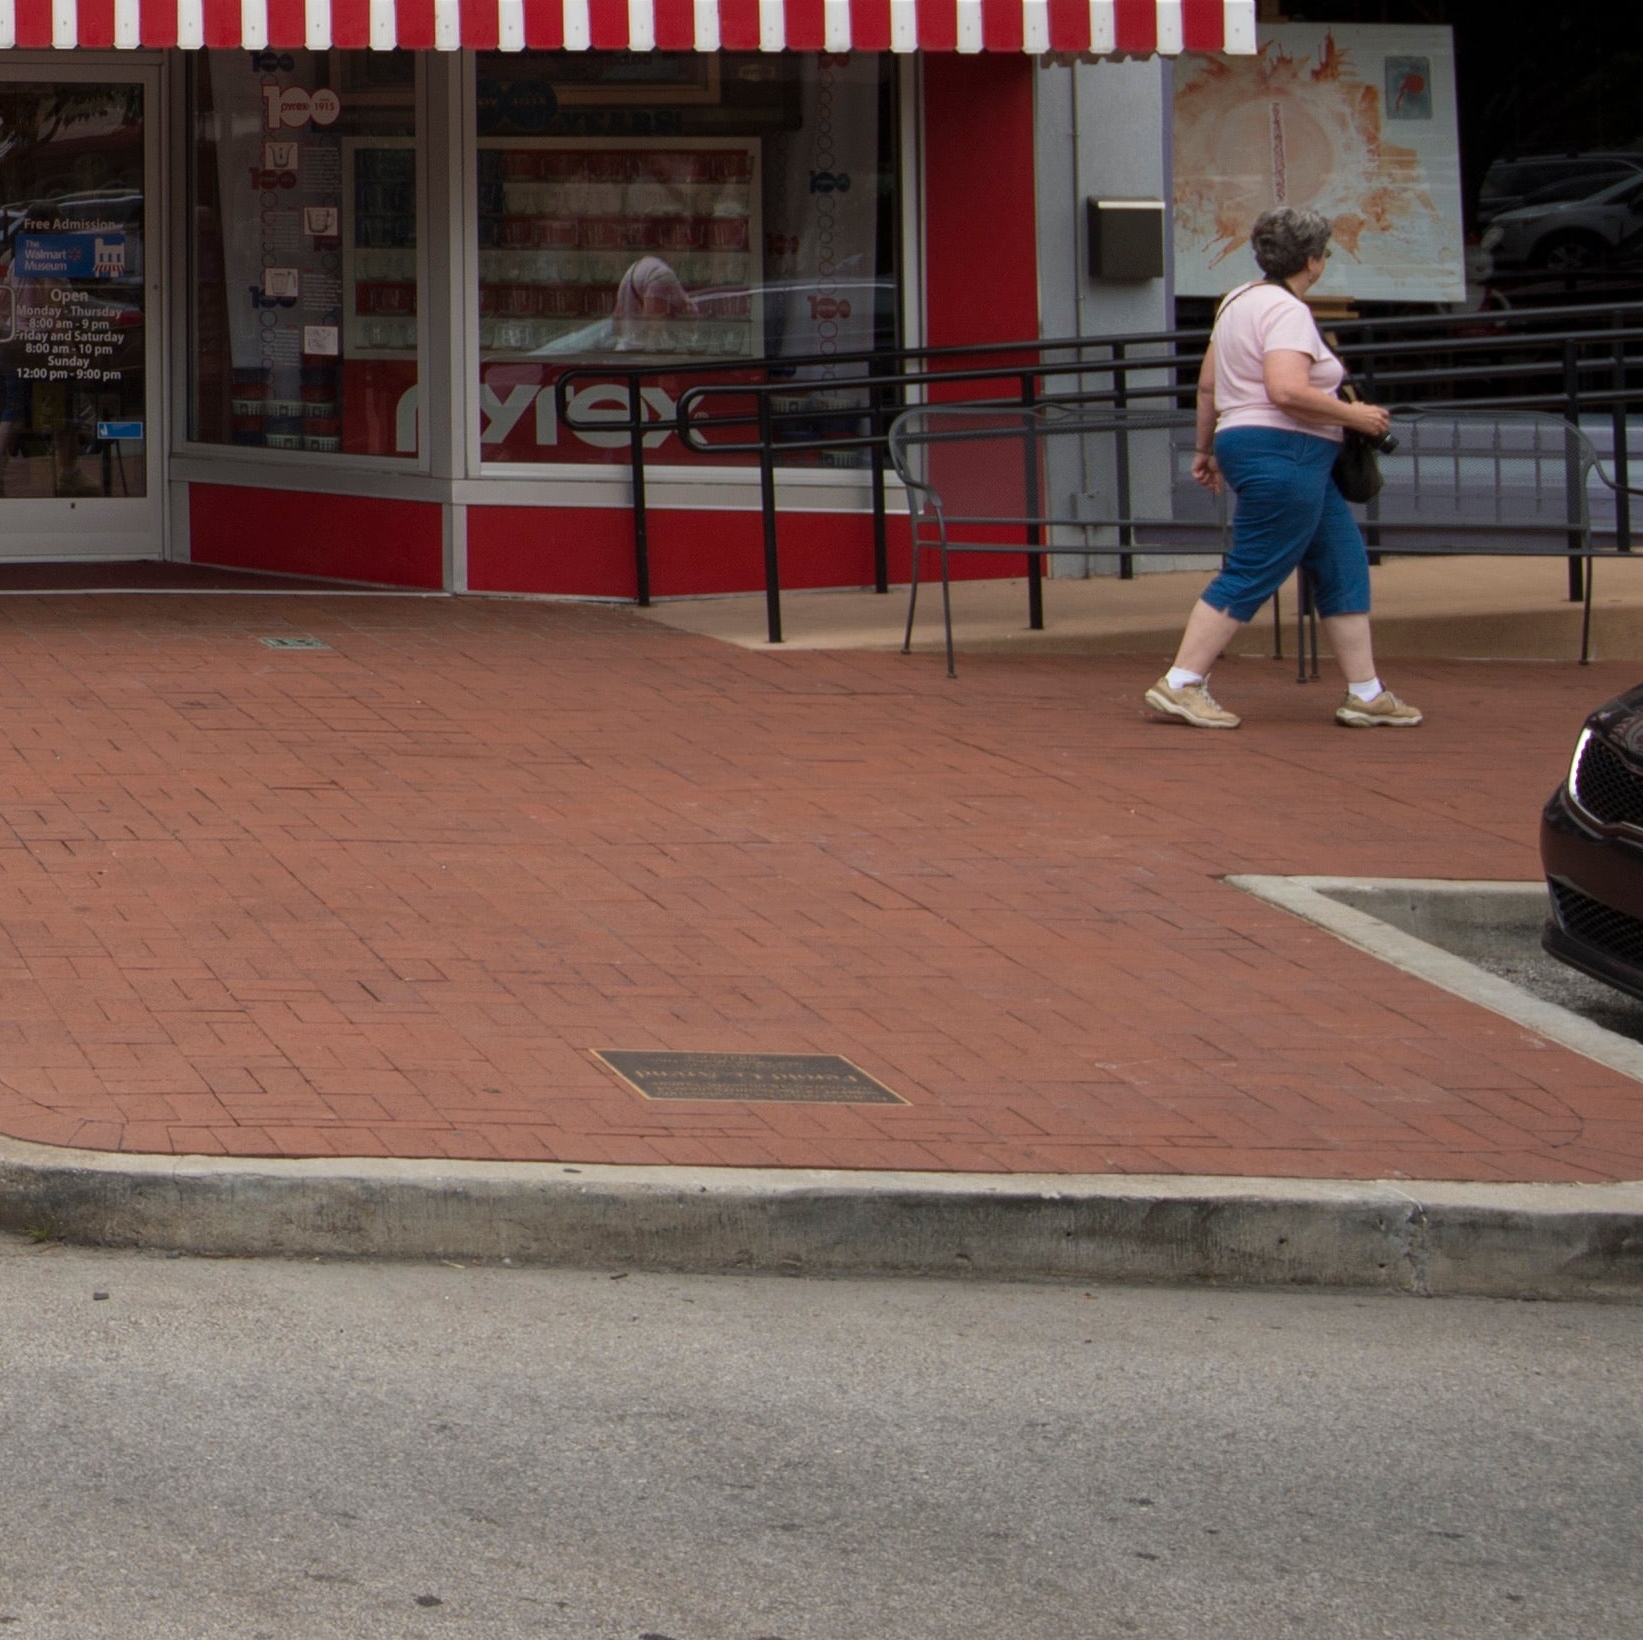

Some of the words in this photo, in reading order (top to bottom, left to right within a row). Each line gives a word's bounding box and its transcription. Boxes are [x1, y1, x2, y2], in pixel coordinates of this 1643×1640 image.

[24, 219, 50, 230] Free
[53, 218, 116, 230] Admission
[25, 249, 67, 260] Walmart
[25, 261, 67, 271] Museum
[50, 289, 89, 304] Open
[17, 305, 62, 318] Monday
[70, 305, 123, 319] Thursday
[29, 319, 53, 329] 8:00
[55, 321, 73, 329] am
[82, 319, 89, 329] 9
[91, 321, 110, 331] pm
[51, 330, 72, 341] and
[74, 330, 125, 344] Saturday
[25, 343, 50, 353] 8:00
[52, 345, 70, 354] am
[79, 344, 92, 354] 10
[95, 346, 113, 356] pm
[48, 355, 90, 369] Sunday
[16, 368, 47, 379] 12:00
[49, 370, 68, 381] pm
[76, 369, 101, 379] 9:00
[103, 371, 122, 381] pm
